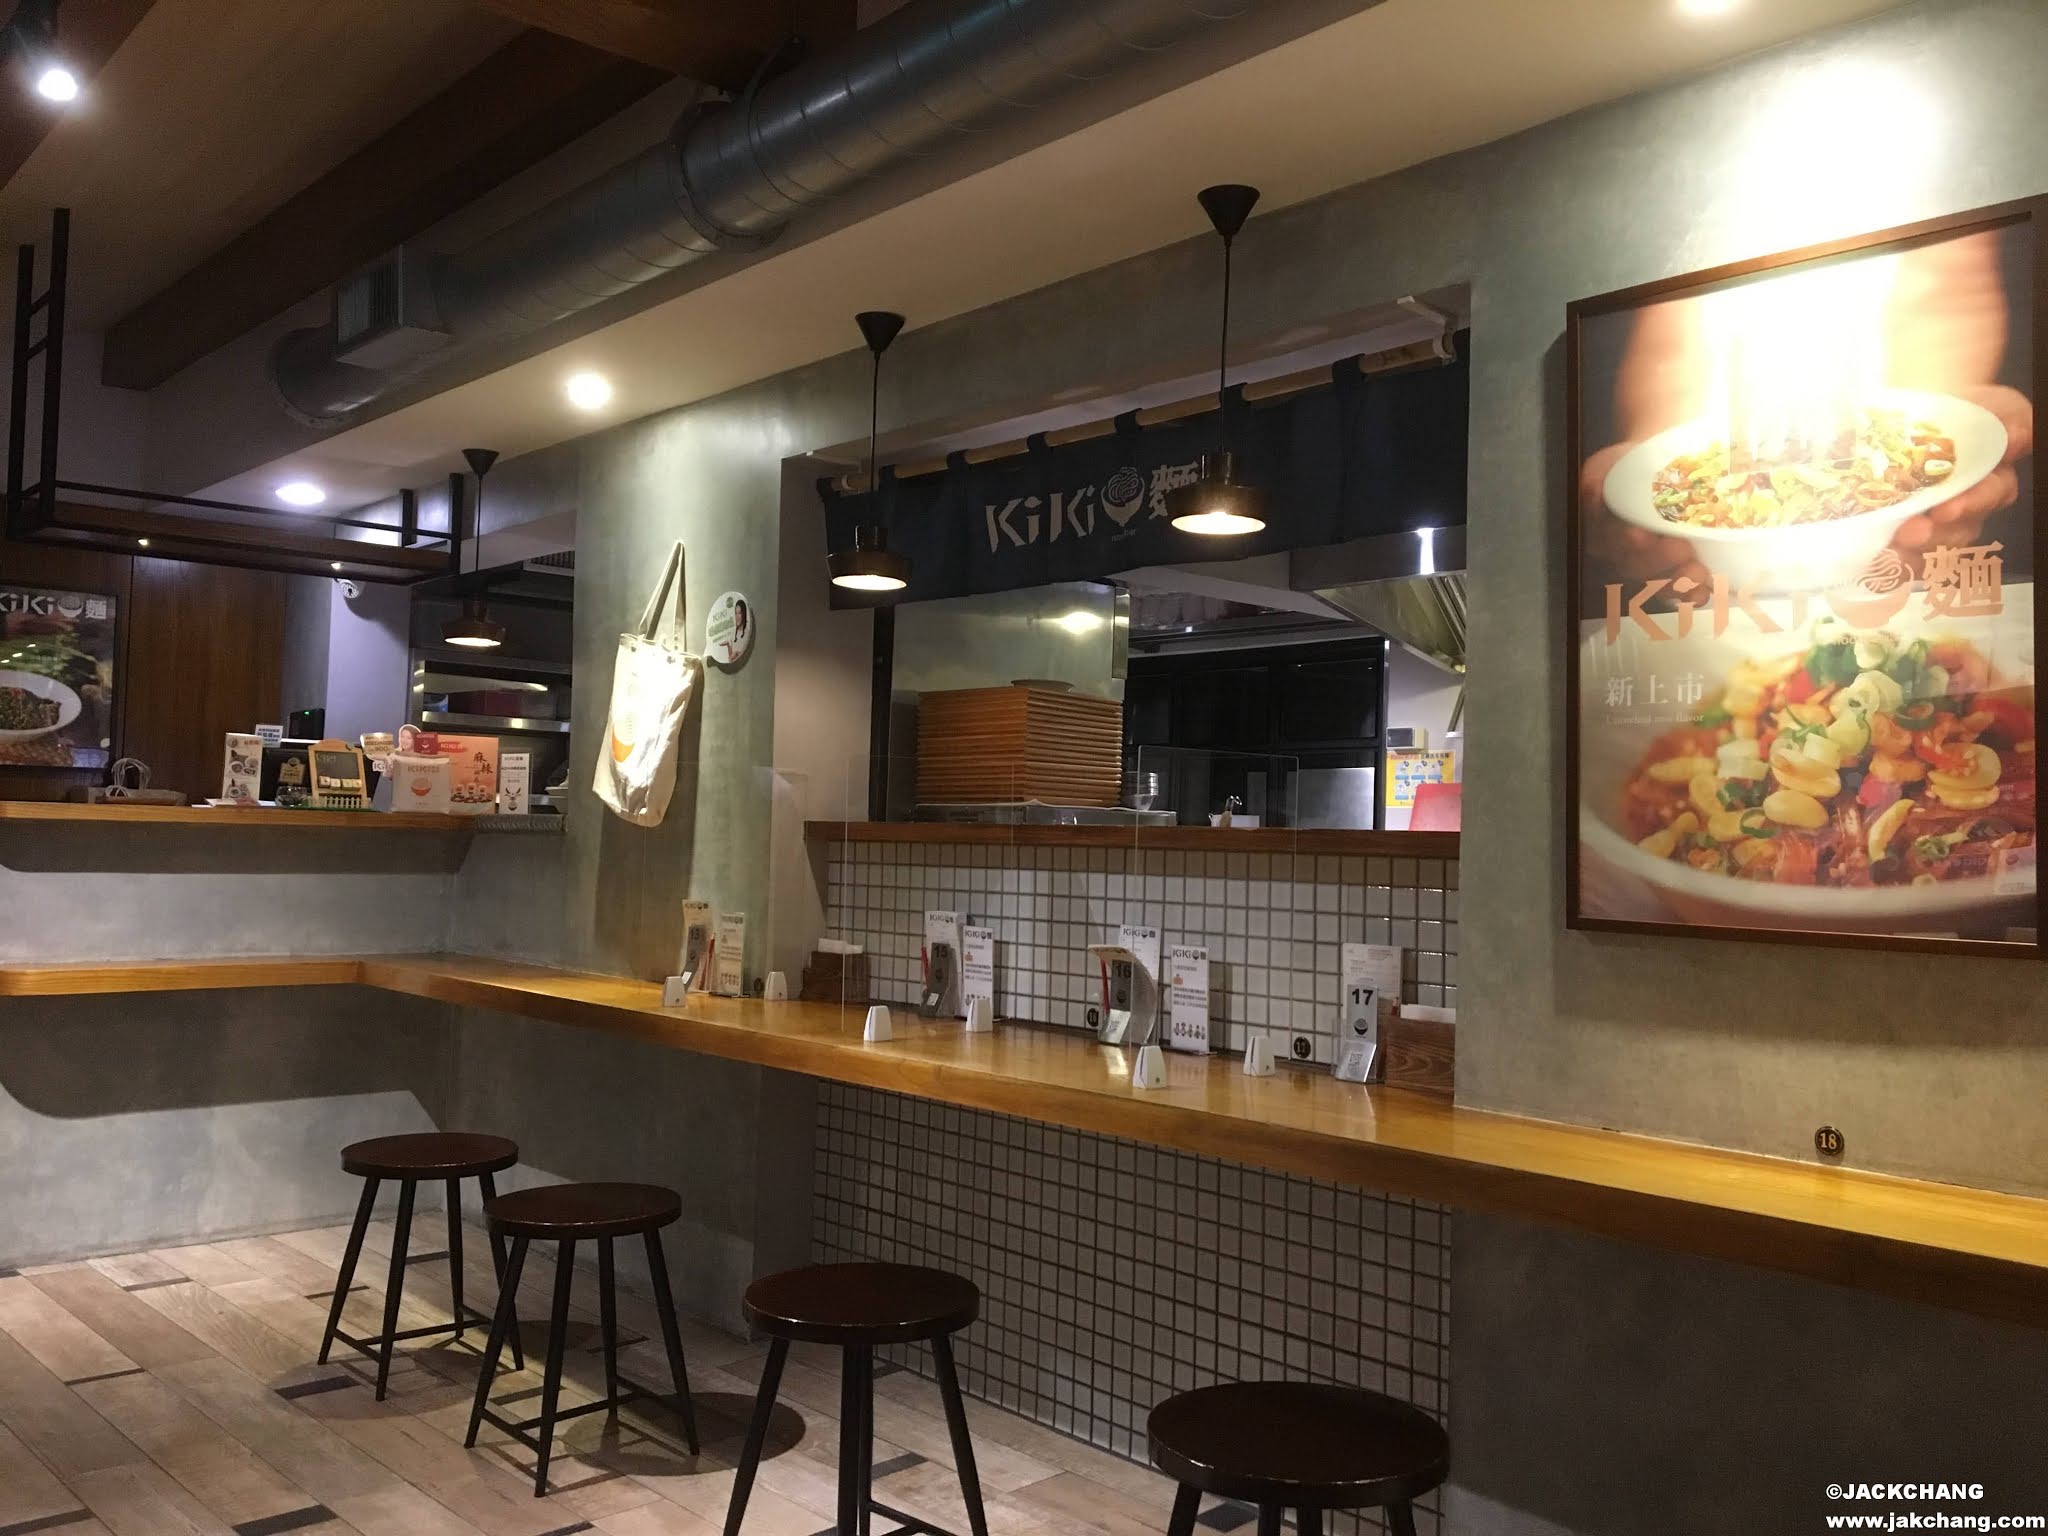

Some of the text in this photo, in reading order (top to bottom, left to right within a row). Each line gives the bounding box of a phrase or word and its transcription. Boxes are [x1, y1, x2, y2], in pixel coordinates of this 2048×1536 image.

[985, 484, 1096, 553] KiKi
[1604, 540, 2004, 646] KiKi 麵
[1604, 673, 1704, 706] 新上市
[1116, 962, 1132, 978] 16
[1351, 988, 1374, 1005] 17
[1820, 1132, 1838, 1150] 18
